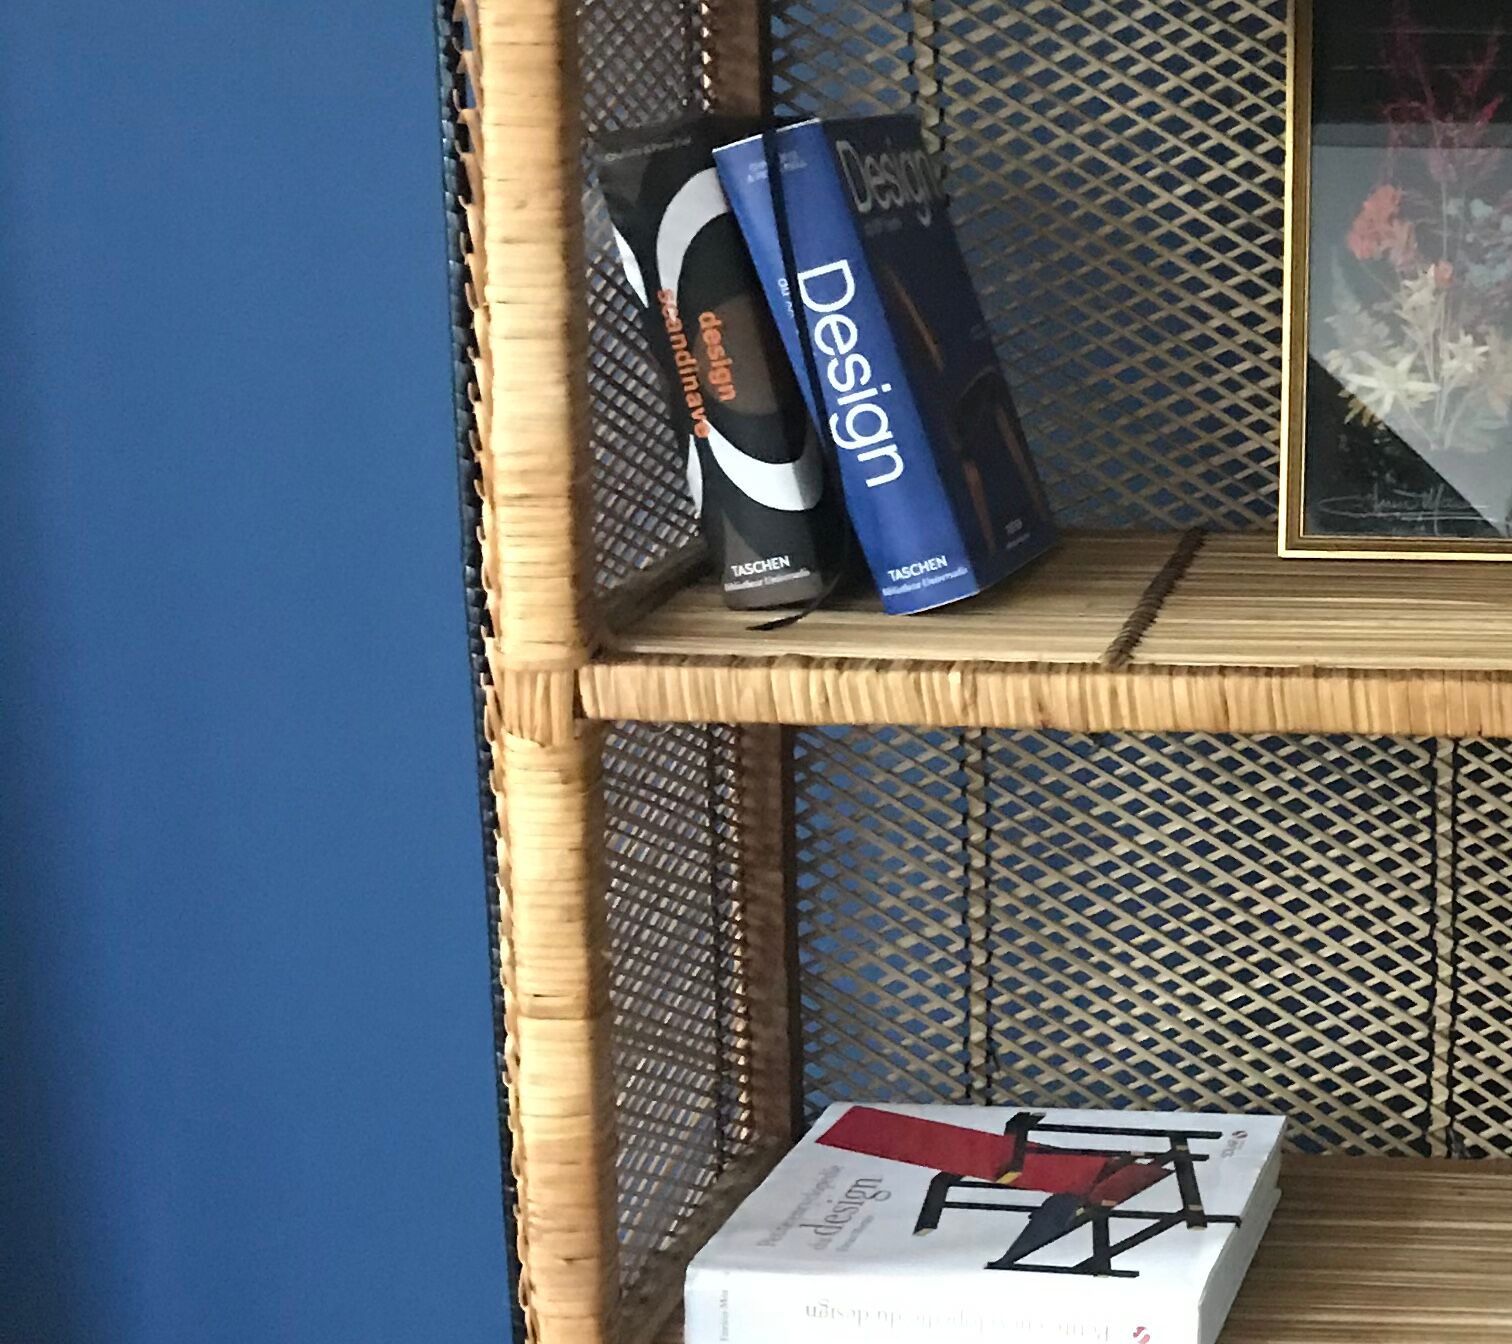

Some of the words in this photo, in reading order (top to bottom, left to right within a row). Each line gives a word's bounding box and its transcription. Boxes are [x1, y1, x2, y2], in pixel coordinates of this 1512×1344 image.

[698, 311, 737, 402] design
[797, 259, 904, 488] Design
[731, 555, 790, 578] TASCHEN
[888, 555, 948, 582] TASCHEN
[799, 1177, 892, 1236] design
[806, 1298, 870, 1327] design
